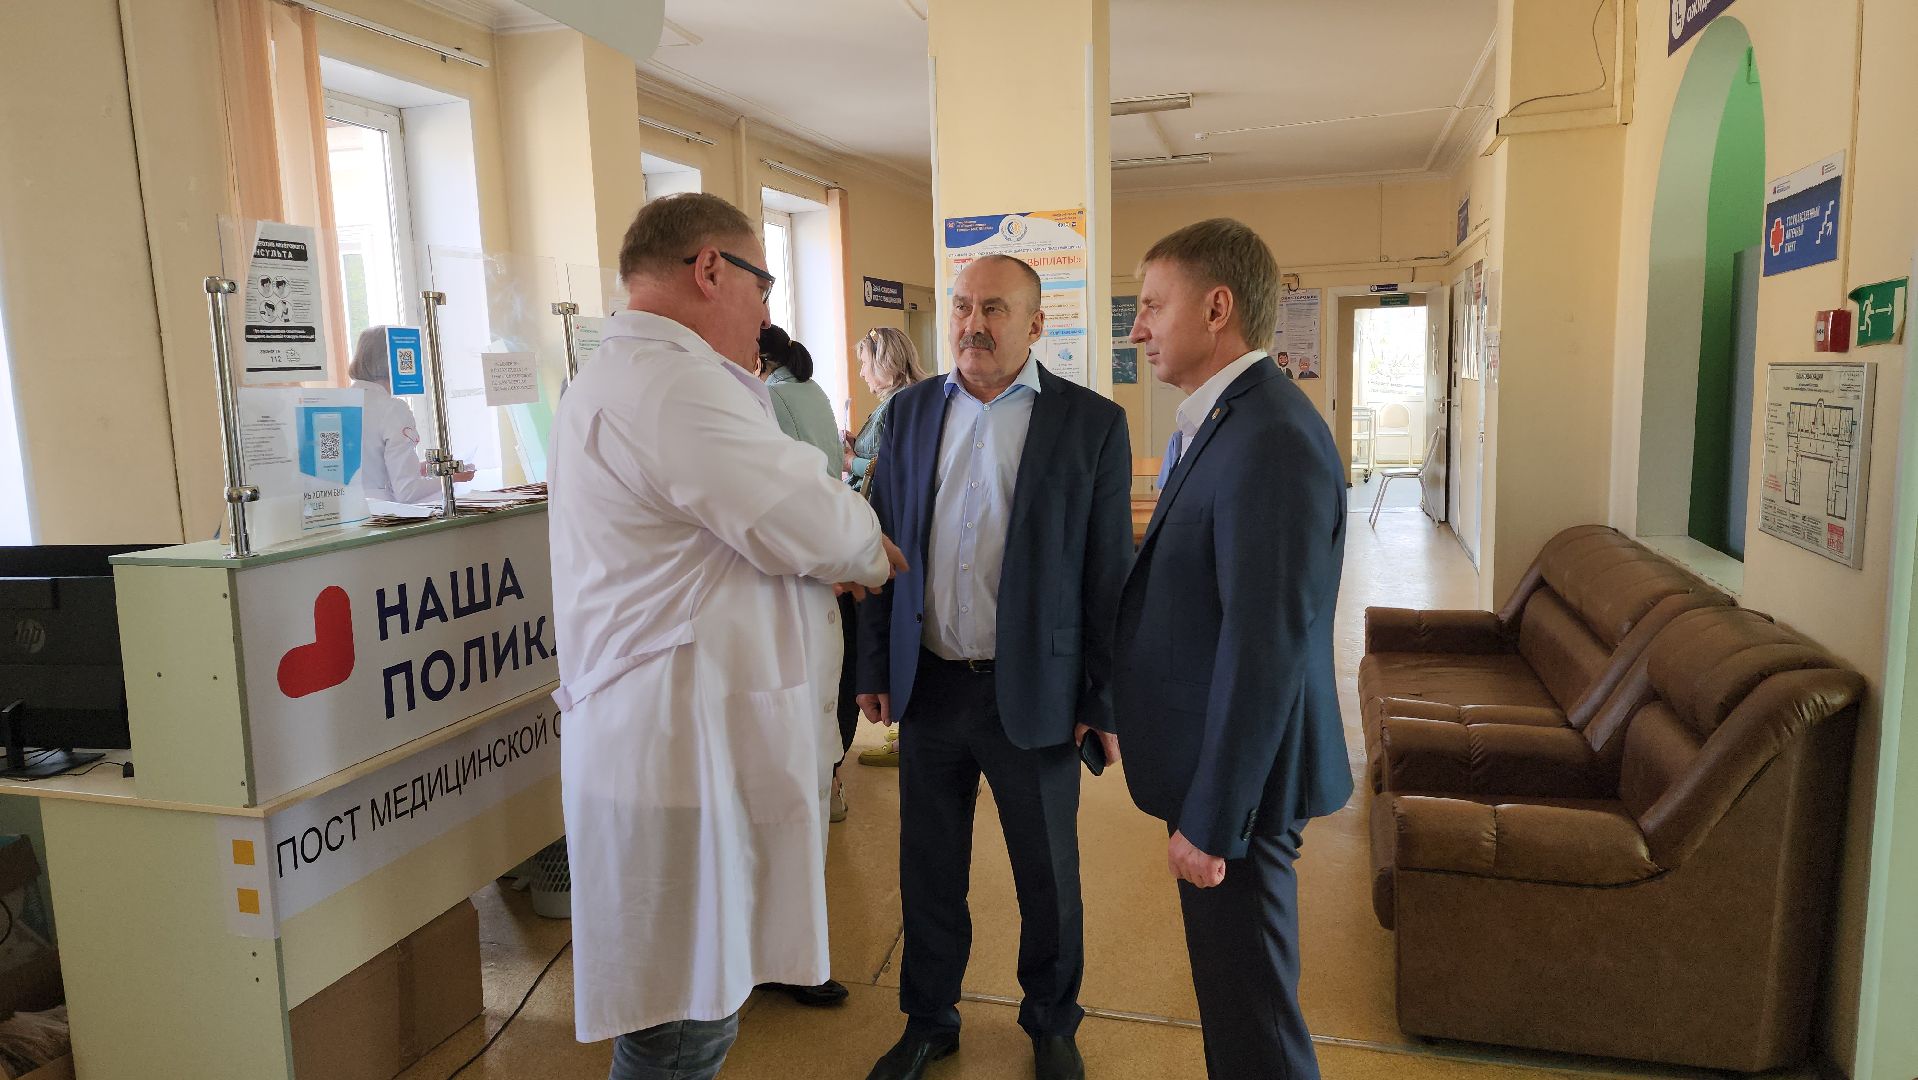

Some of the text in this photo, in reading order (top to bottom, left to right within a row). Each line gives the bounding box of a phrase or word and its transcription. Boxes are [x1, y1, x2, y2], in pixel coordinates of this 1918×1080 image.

[376, 557, 525, 642] НАША
[383, 615, 557, 720] ПОЛИК
[276, 805, 361, 878] ПОСТ
[370, 713, 548, 831] МЕДИЦИНСКОЙ
